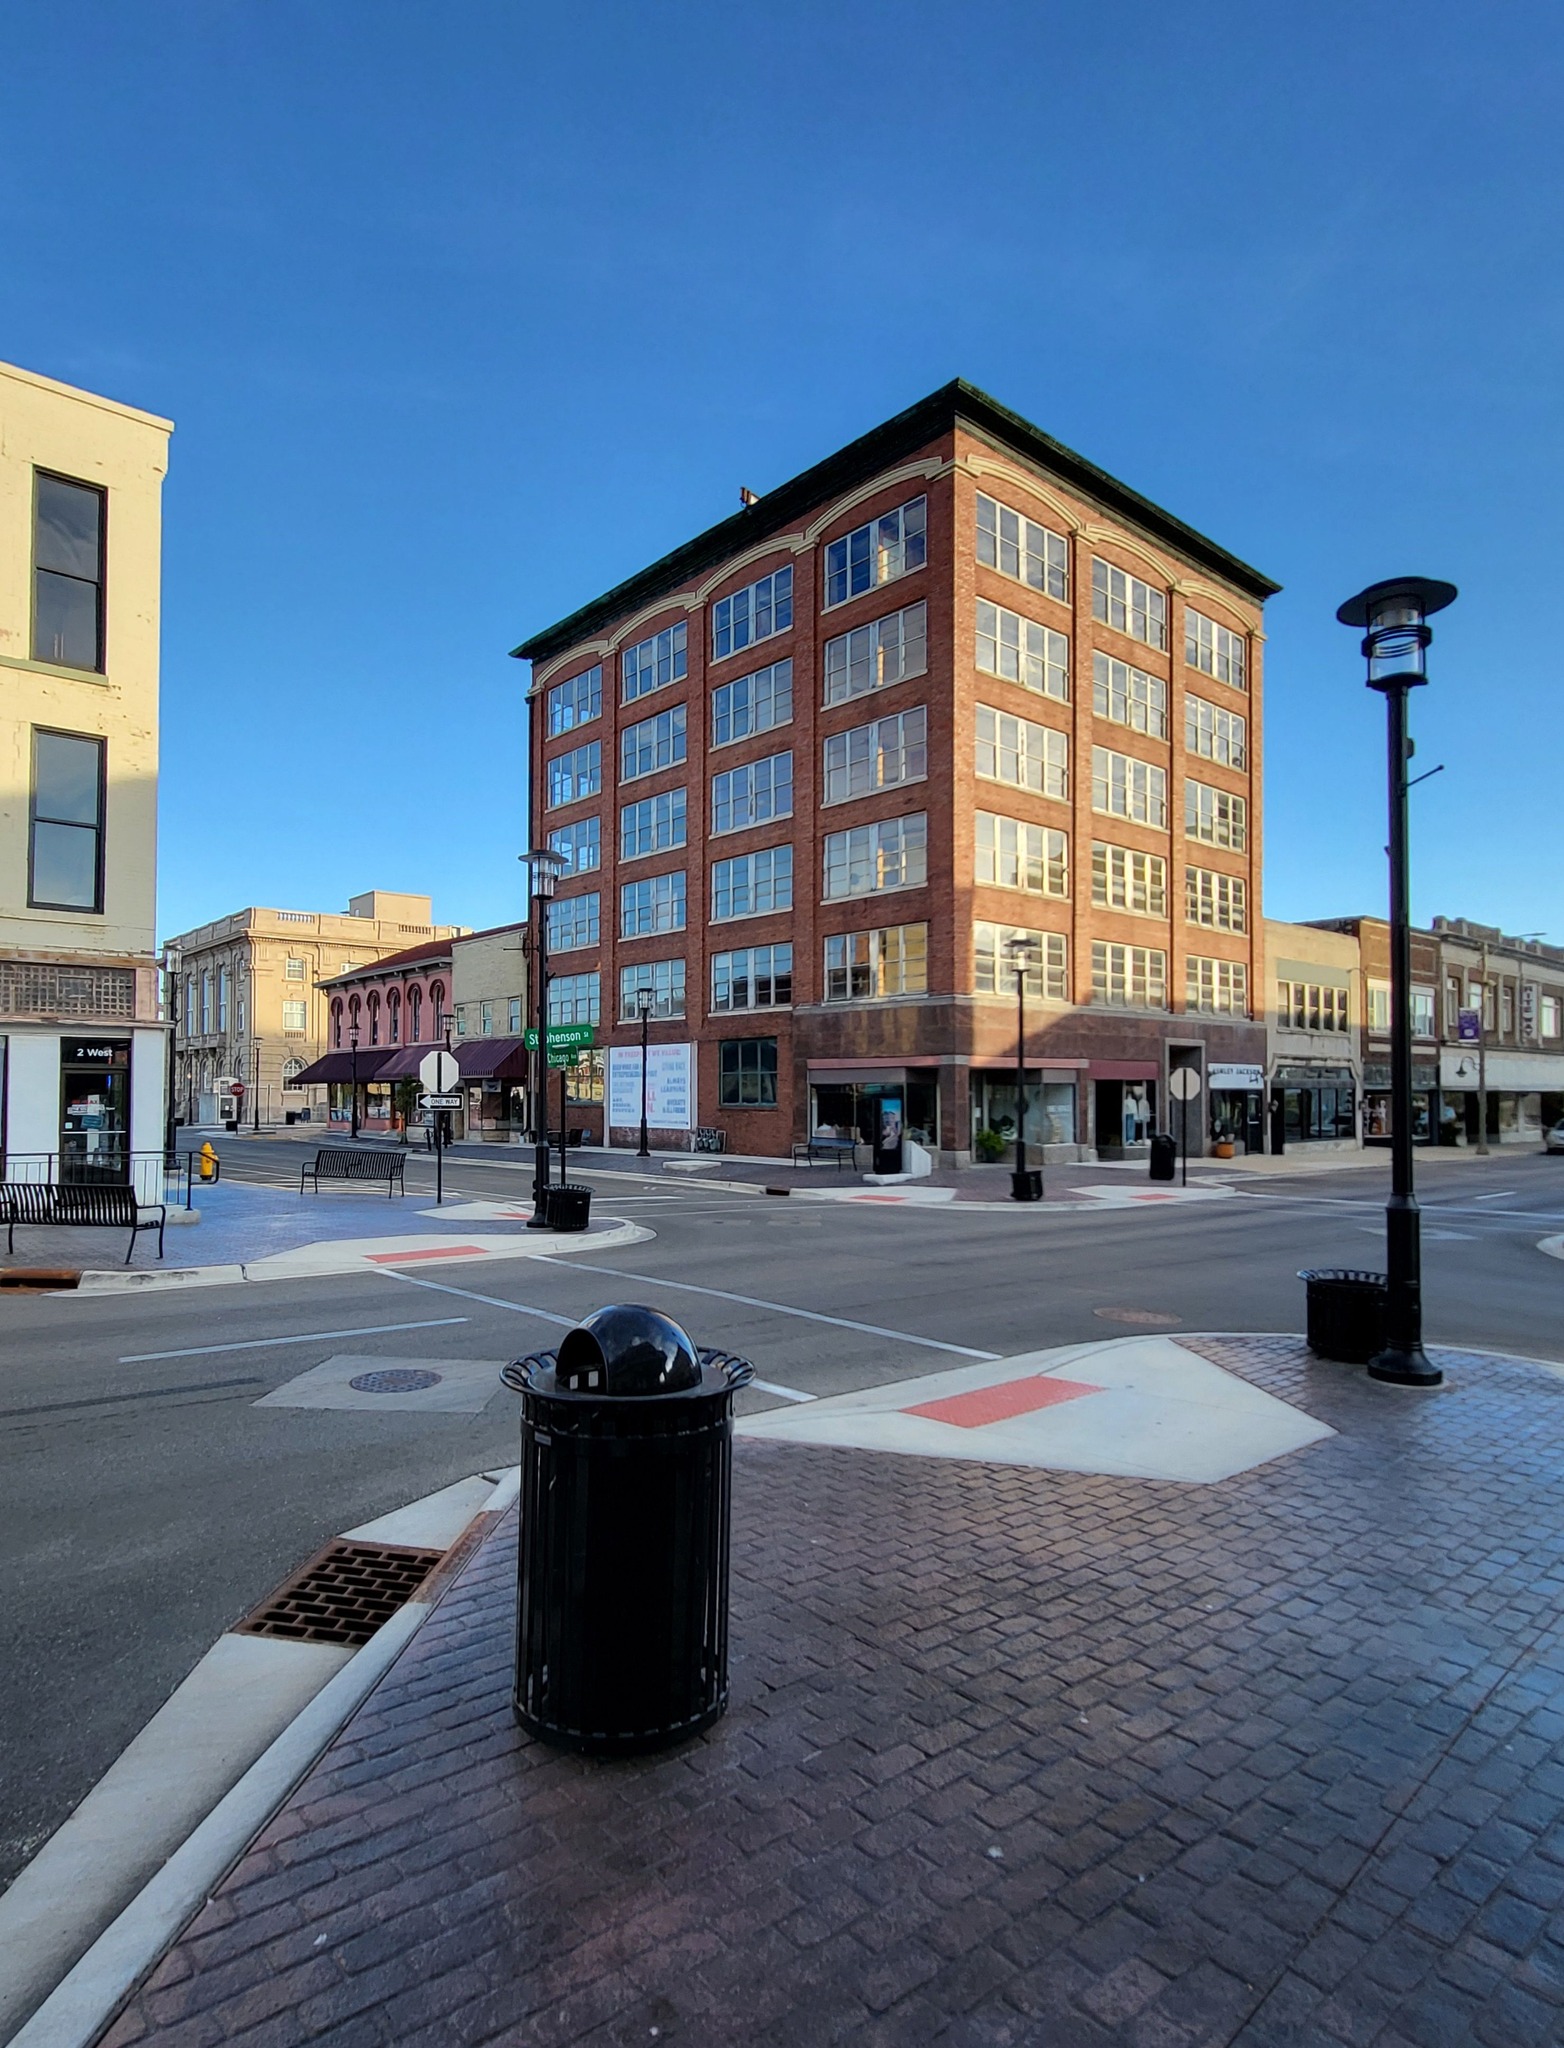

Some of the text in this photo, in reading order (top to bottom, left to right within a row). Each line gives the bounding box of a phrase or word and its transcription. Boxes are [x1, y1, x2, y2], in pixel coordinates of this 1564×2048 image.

[529, 1032, 581, 1045] Sthenson
[77, 1048, 113, 1056] 2 West
[547, 1053, 570, 1065] Chicago
